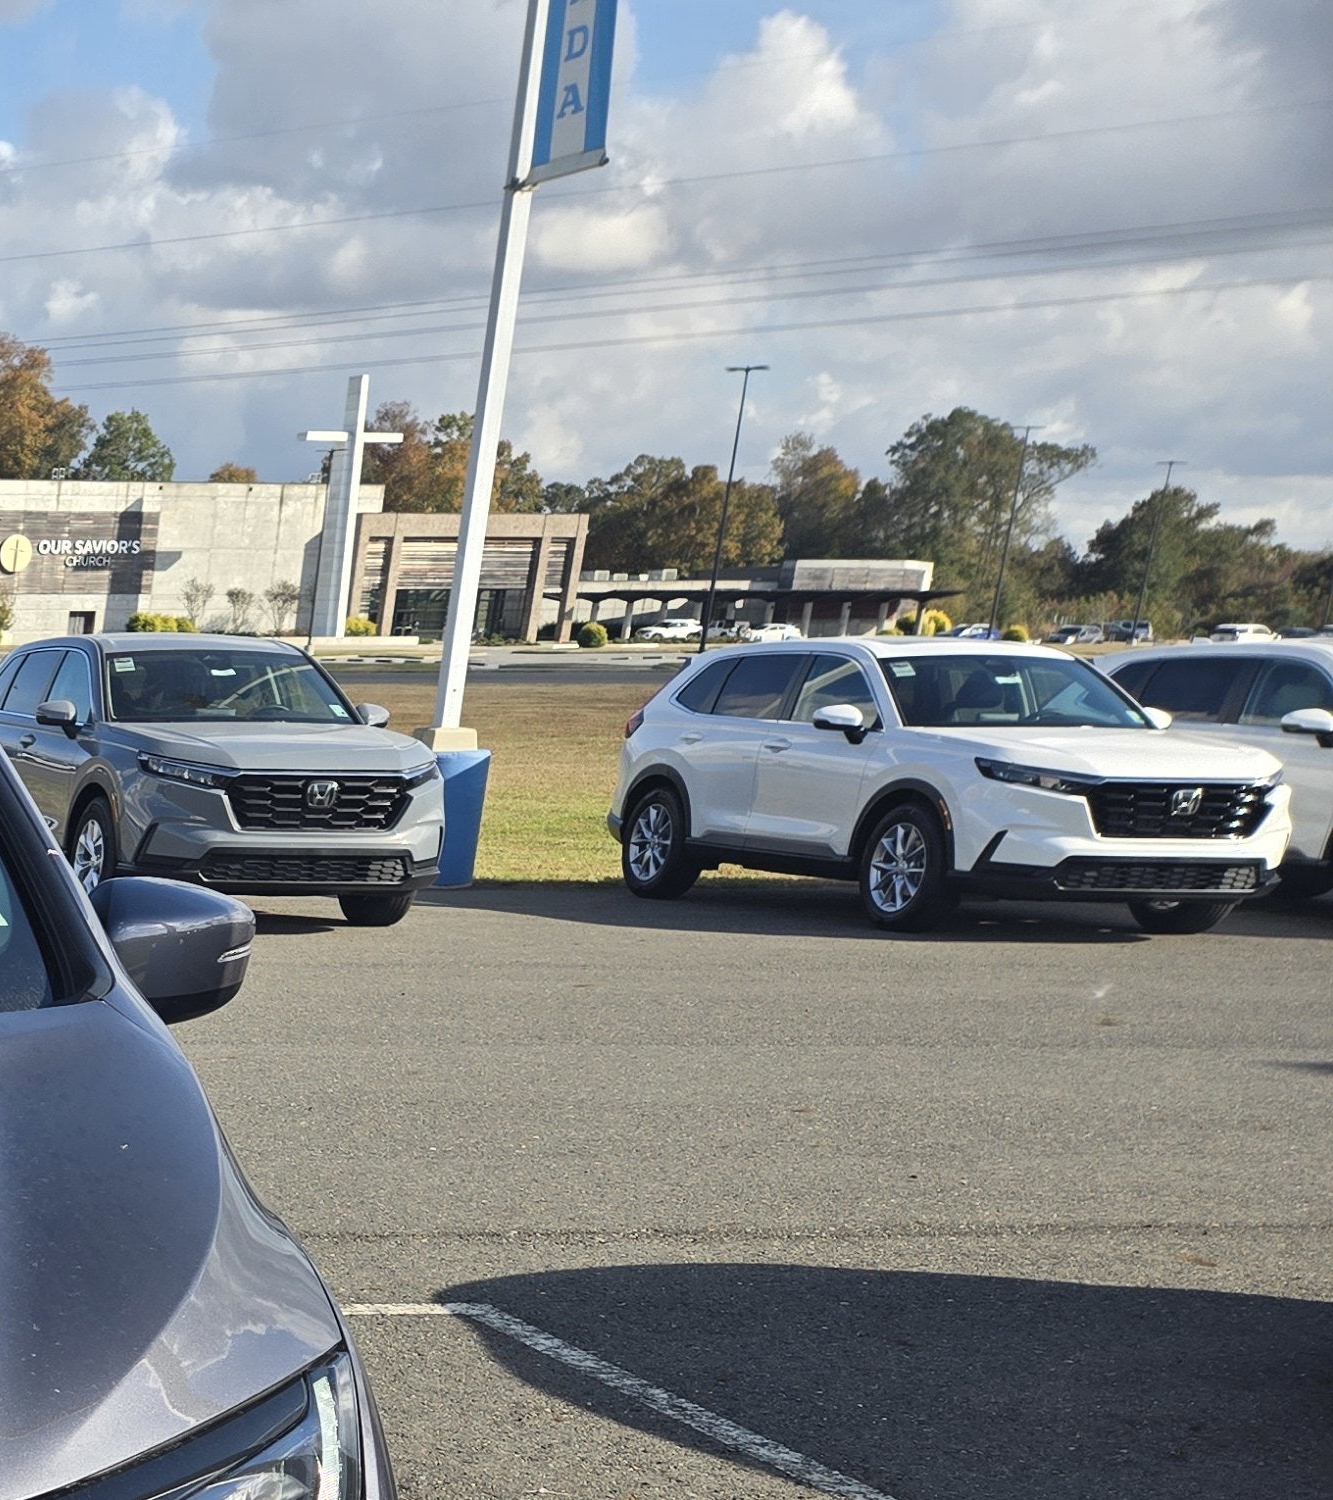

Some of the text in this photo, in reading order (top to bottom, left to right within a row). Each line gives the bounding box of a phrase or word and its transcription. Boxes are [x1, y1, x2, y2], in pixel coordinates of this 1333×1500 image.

[556, 0, 590, 120] DA
[38, 539, 141, 555] OUR SAVIOR'S
[65, 555, 111, 567] CHURCH
